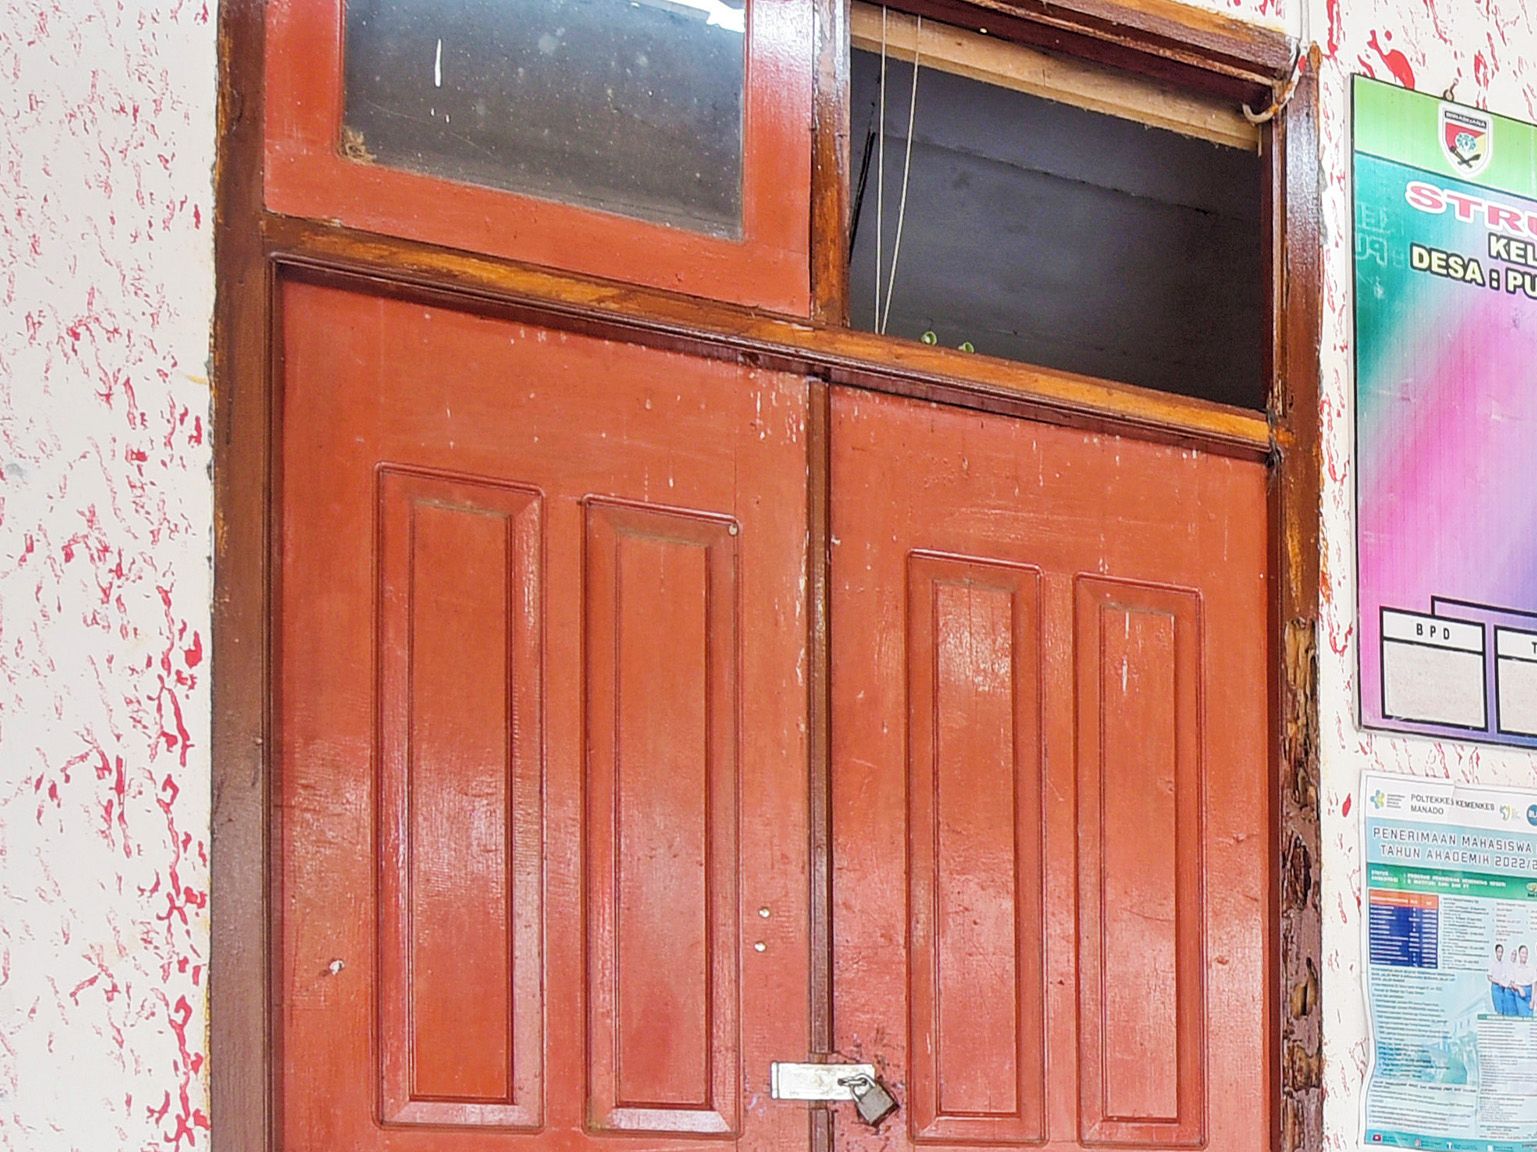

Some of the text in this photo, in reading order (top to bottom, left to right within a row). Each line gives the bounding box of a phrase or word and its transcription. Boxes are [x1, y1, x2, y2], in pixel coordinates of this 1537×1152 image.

[1410, 243, 1484, 286] DESA
[1410, 805, 1444, 815] MANADO
[1373, 827, 1456, 845] PENERIMAAN
[1462, 836, 1532, 854] MAHASISWA
[1380, 844, 1420, 859] TAHUN
